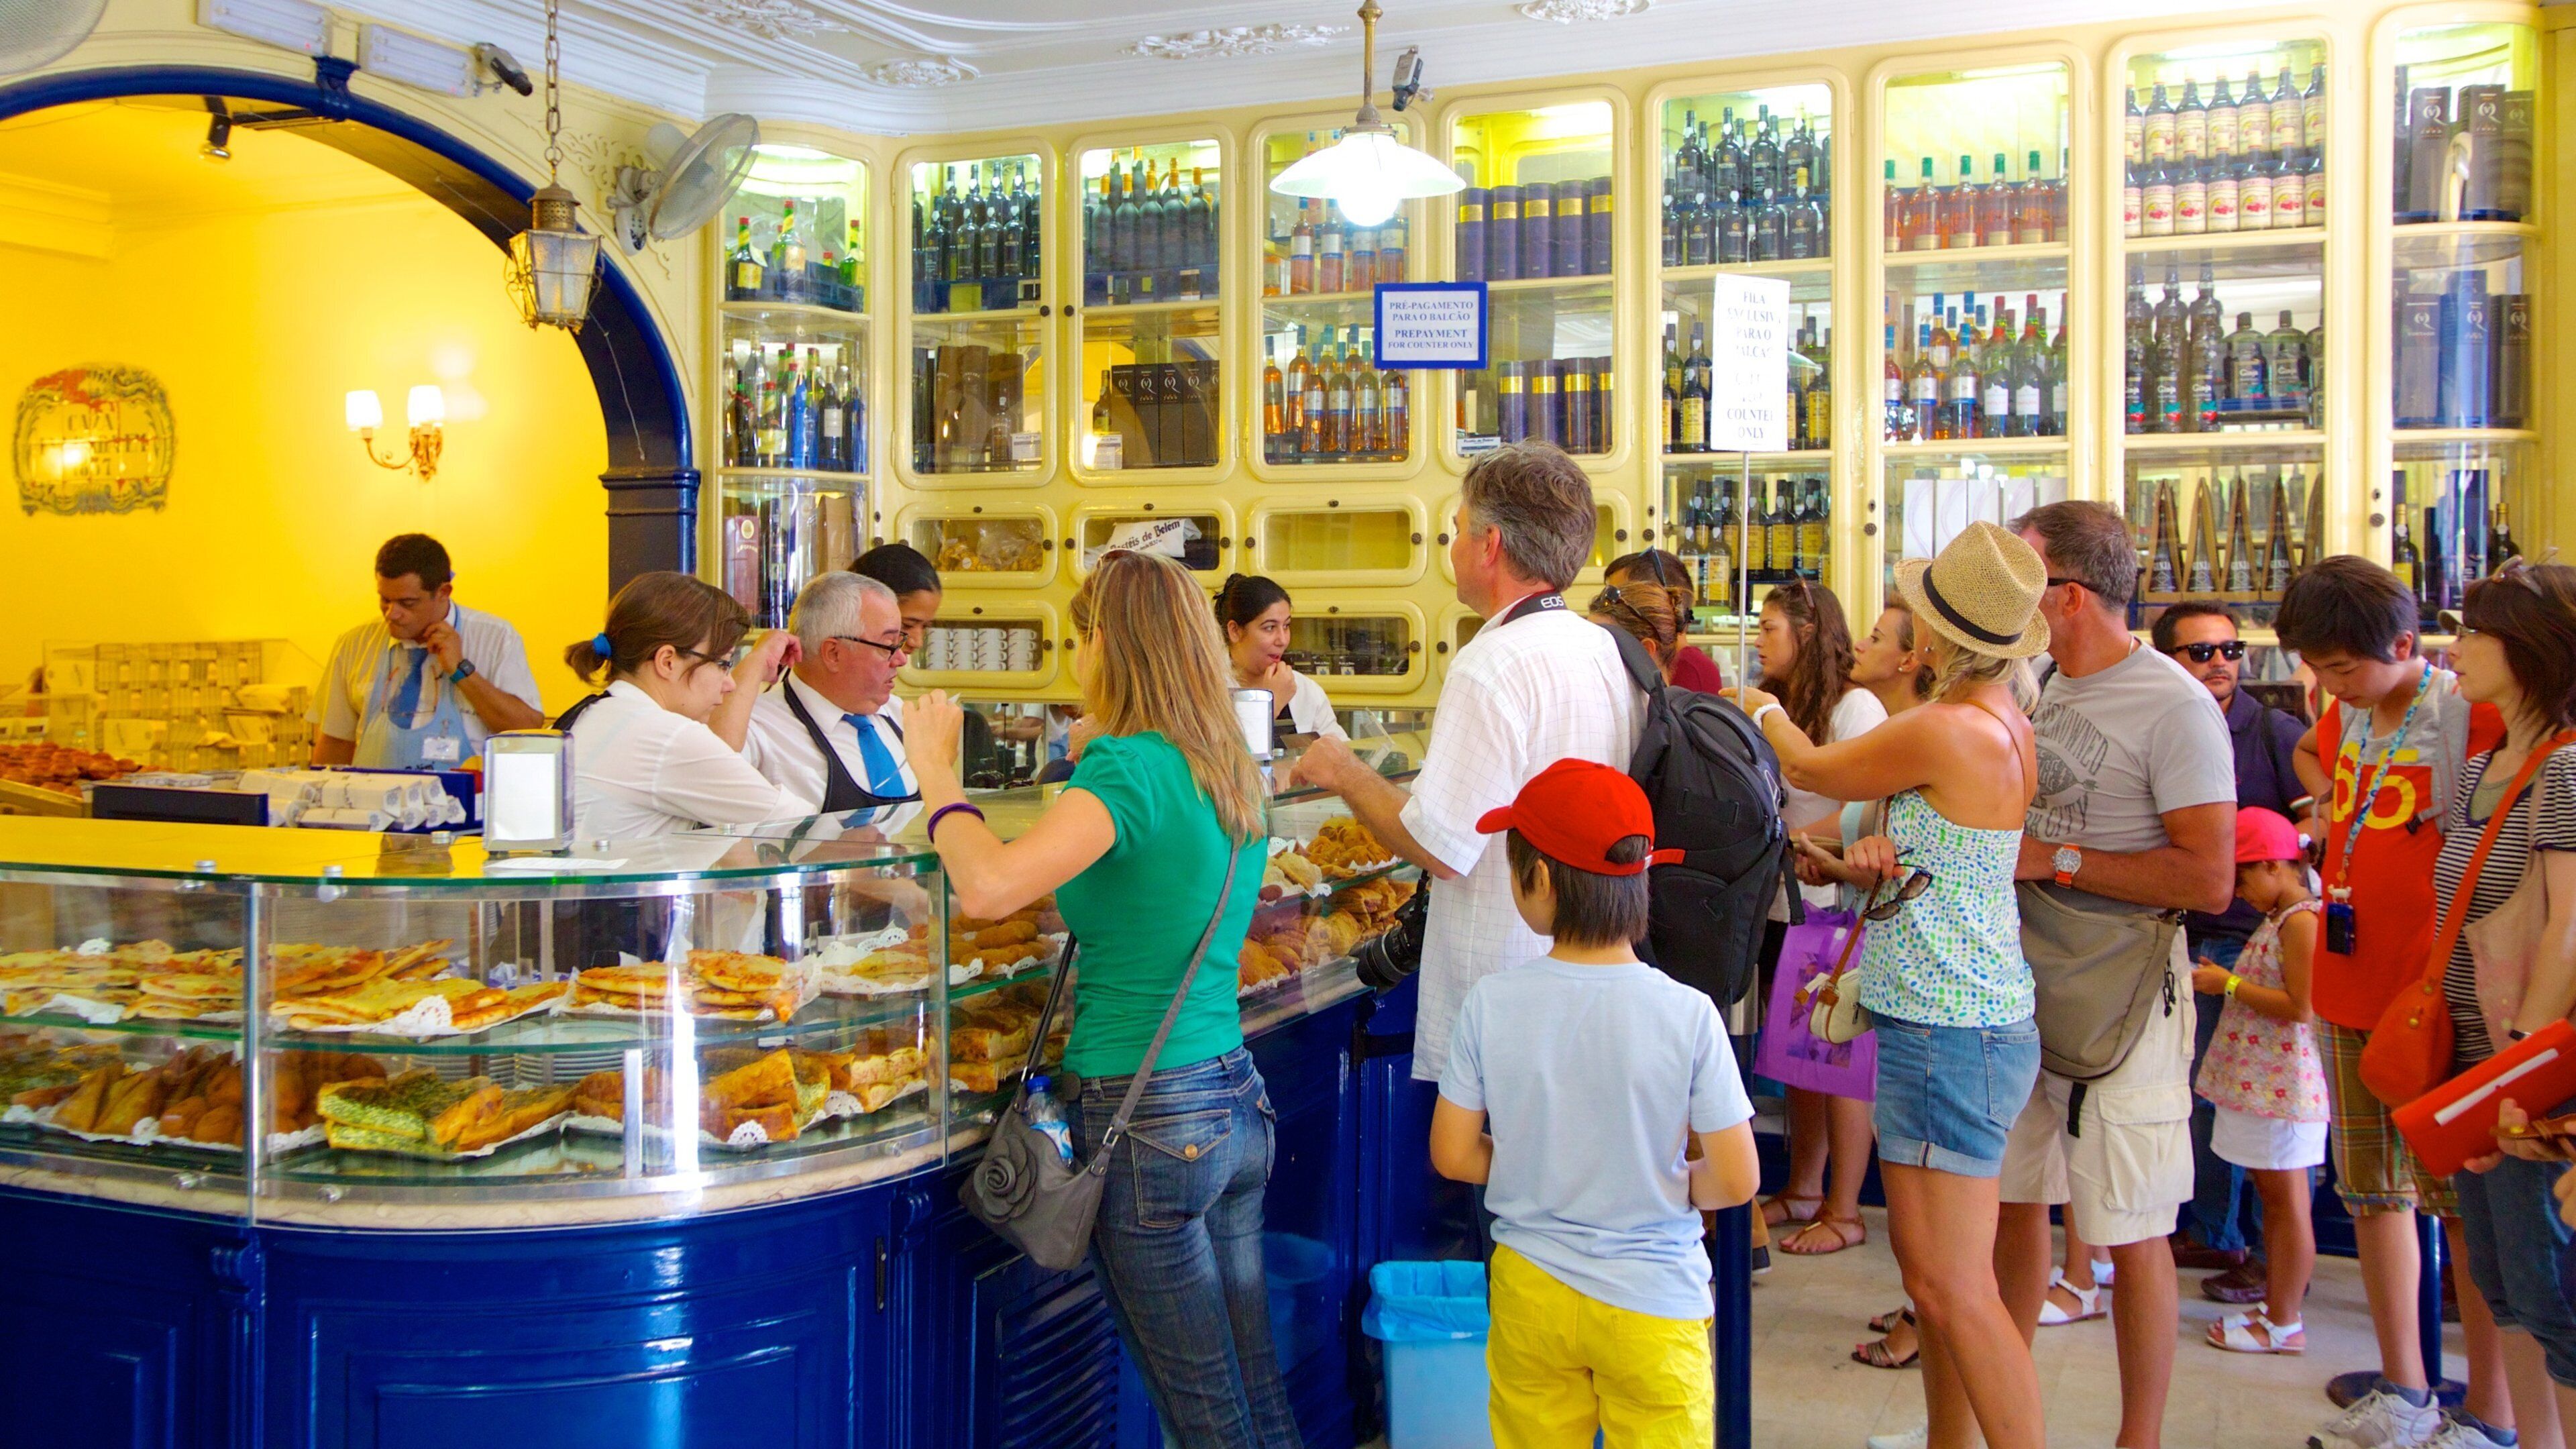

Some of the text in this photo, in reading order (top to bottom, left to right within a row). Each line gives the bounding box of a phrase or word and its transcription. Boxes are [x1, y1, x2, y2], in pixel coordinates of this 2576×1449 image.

[1389, 300, 1473, 311] PRÉ-PAGAMENTO
[1392, 311, 1470, 321] PARA O BALCÃO
[1395, 329, 1468, 338] PREPAYMENT
[1142, 531, 1152, 542] de
[1540, 596, 1564, 608] EOS
[2045, 791, 2089, 838] CITY
